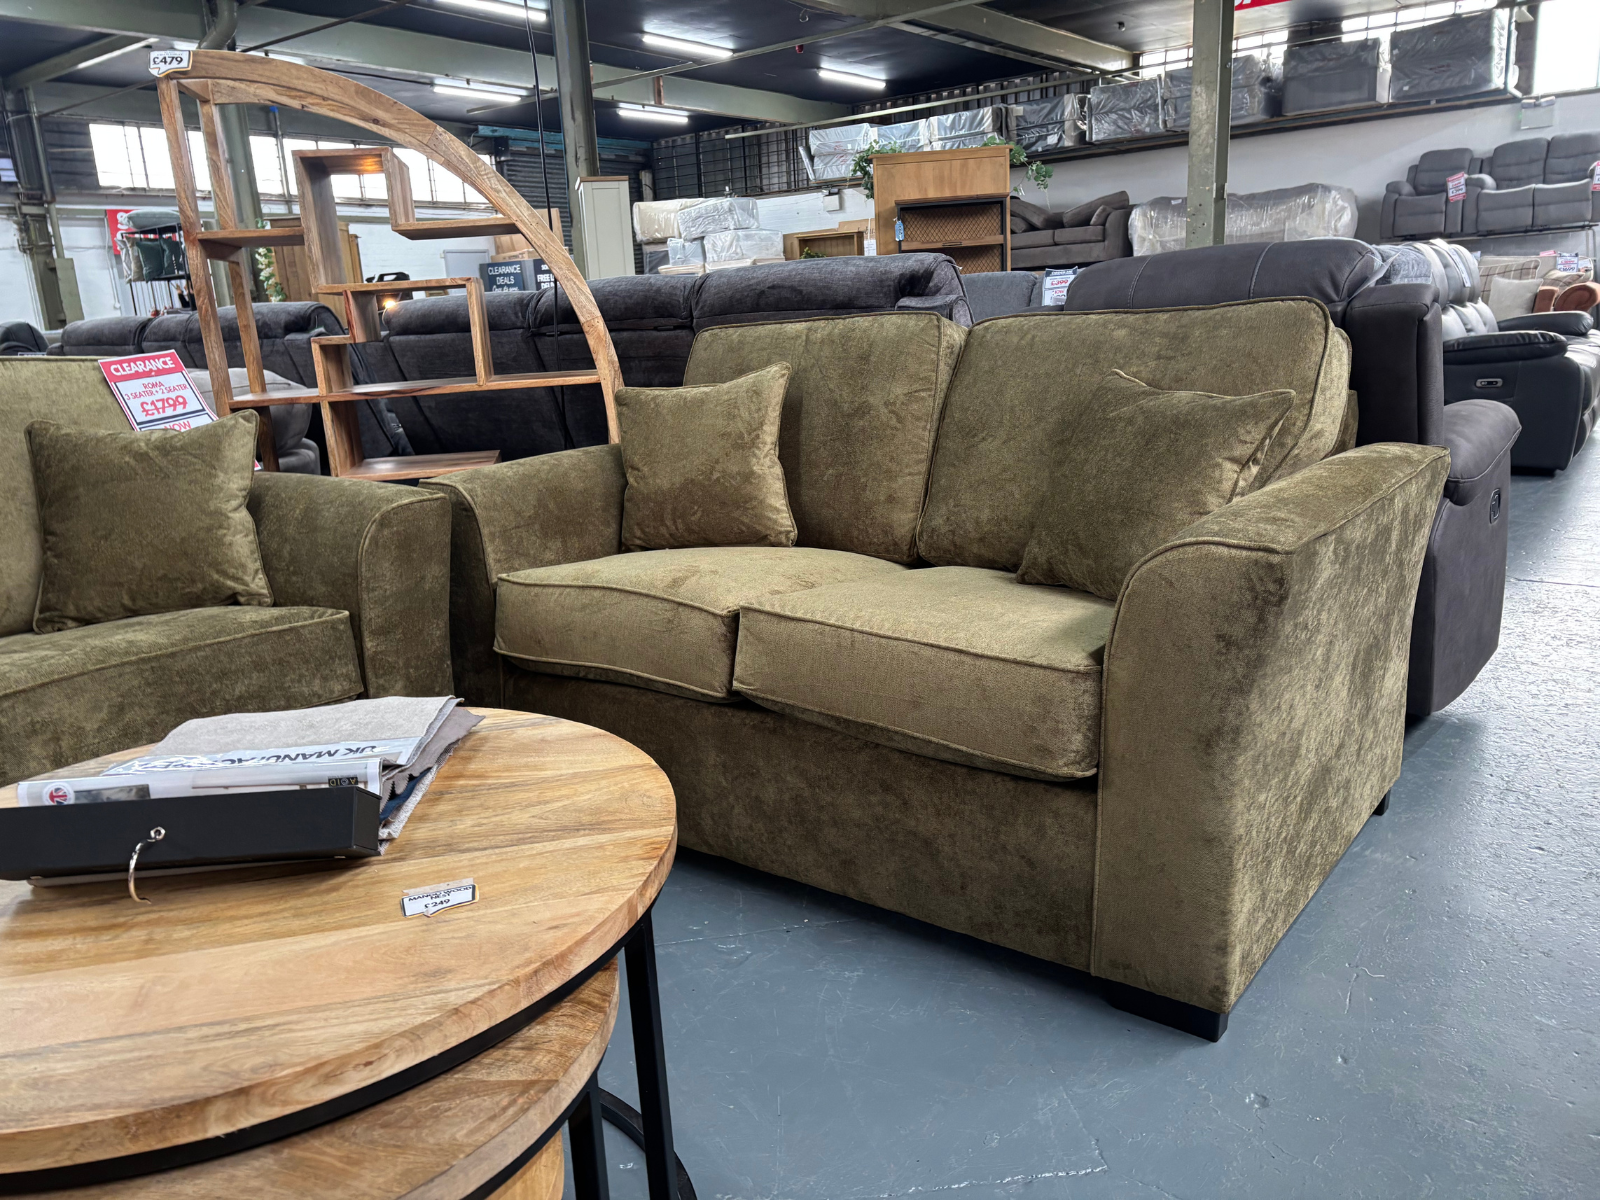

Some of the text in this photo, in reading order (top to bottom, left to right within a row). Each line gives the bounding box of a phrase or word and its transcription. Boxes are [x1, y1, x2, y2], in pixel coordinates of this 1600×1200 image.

[152, 56, 183, 65] £479
[488, 265, 521, 275] CLEARANCE
[496, 276, 514, 284] DEALS
[110, 357, 175, 375] CLEARANCE
[142, 381, 164, 389] ROMA
[124, 393, 131, 401] 3
[130, 389, 156, 400] SEATER
[159, 387, 166, 395] 2
[164, 383, 189, 394] SEATER
[140, 395, 188, 417] £1799
[341, 745, 377, 757] UK
[424, 899, 450, 908] £249
